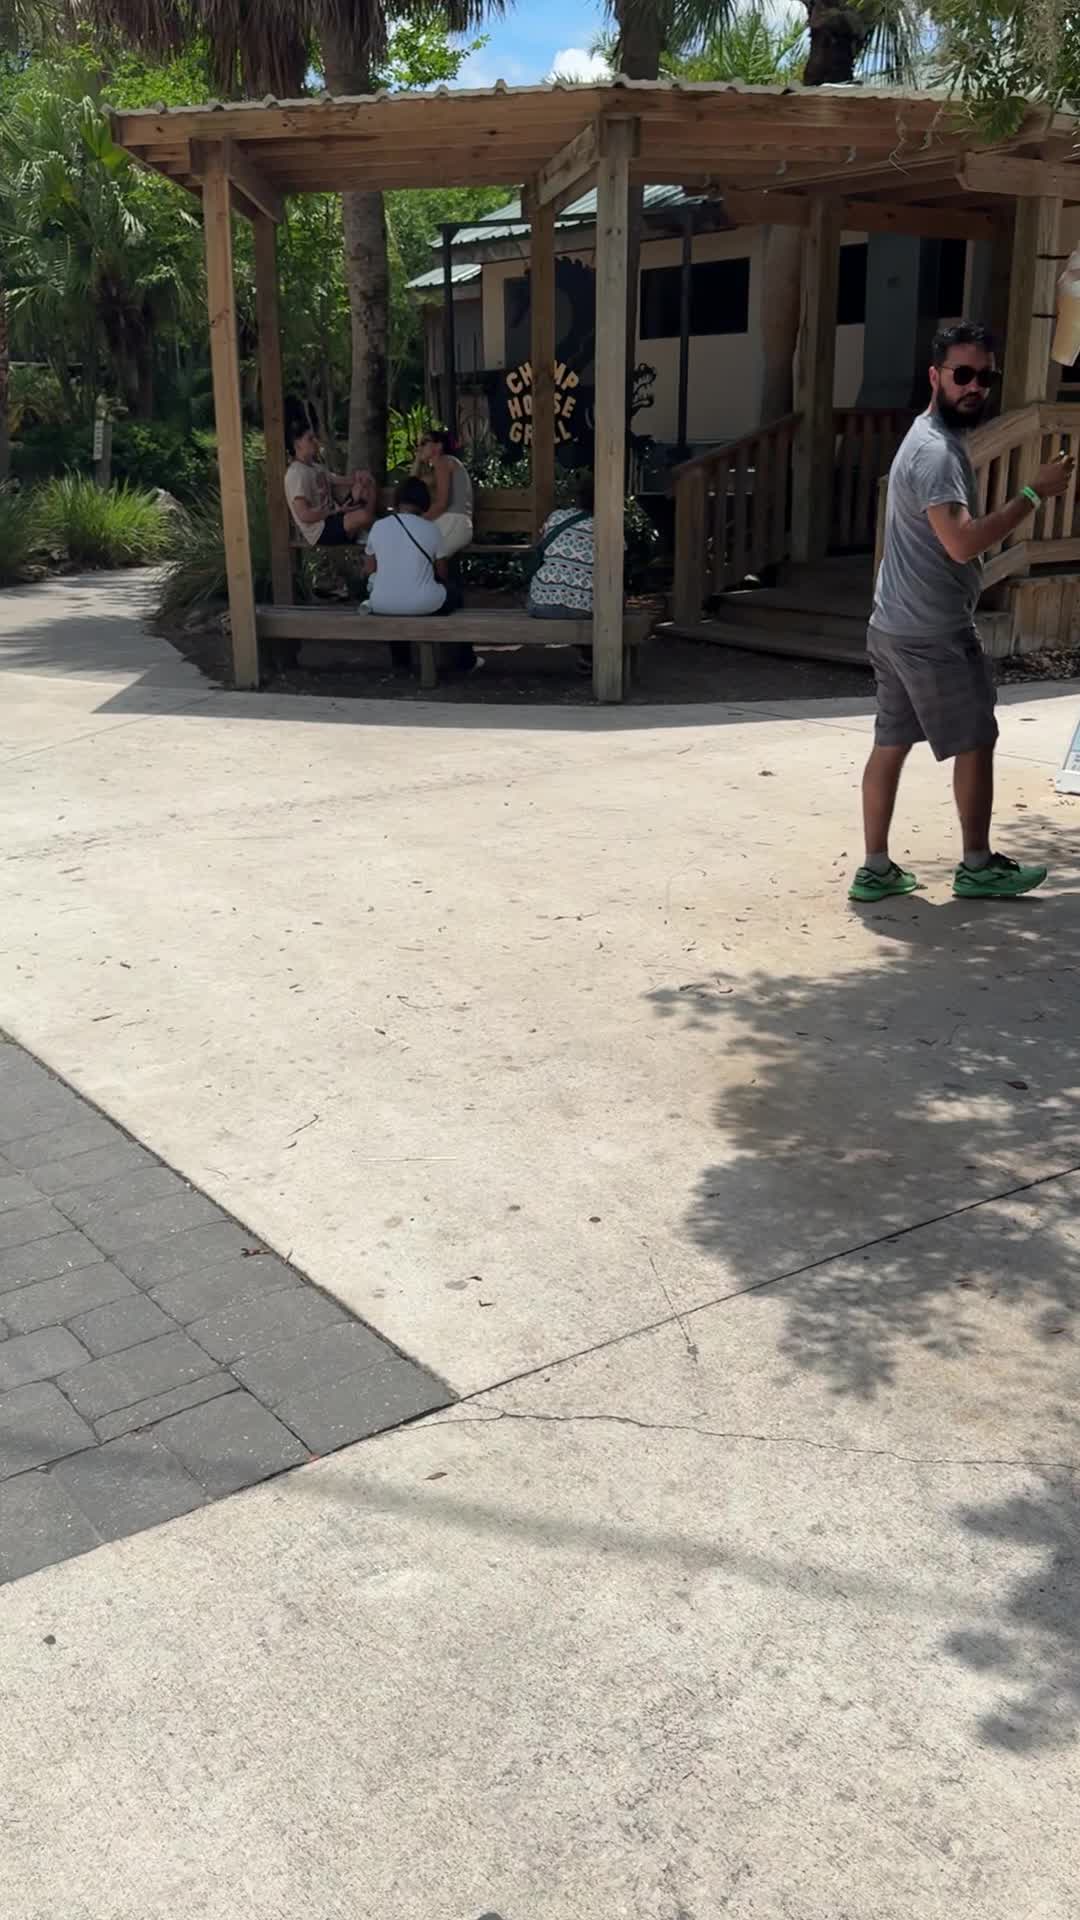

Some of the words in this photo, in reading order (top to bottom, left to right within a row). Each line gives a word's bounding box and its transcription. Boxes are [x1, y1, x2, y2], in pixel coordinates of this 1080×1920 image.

[506, 360, 579, 394] CHMP
[507, 393, 576, 420] HOSE
[509, 420, 572, 445] GRL
